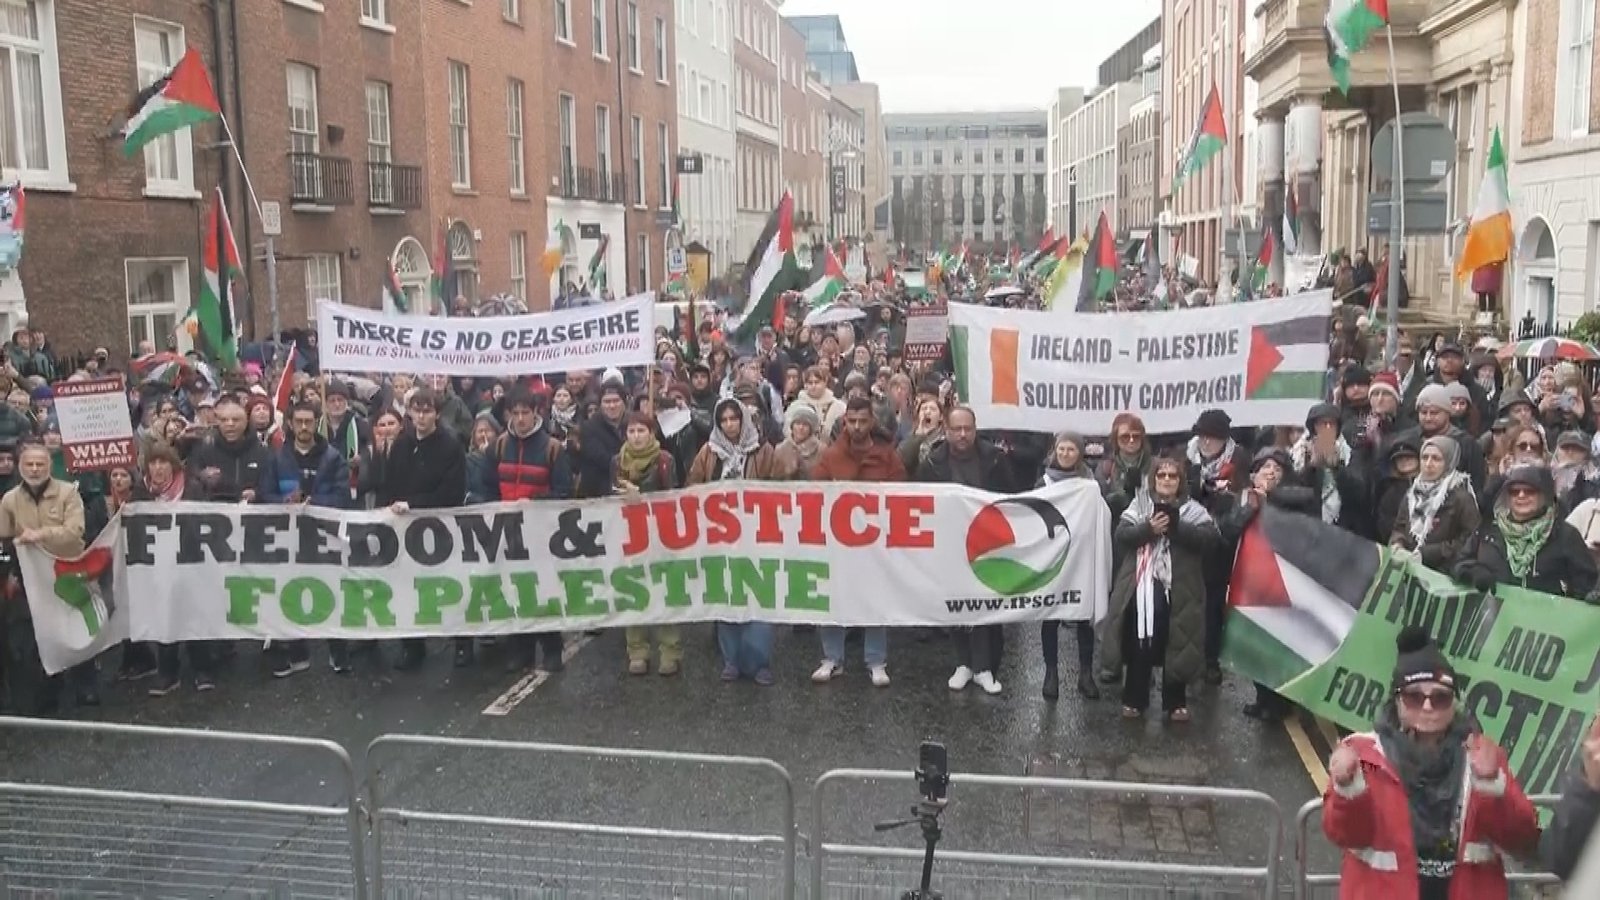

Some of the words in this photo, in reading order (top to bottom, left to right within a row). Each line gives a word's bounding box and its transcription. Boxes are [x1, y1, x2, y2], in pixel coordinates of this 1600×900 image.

[333, 315, 413, 347] THERE
[420, 329, 447, 350] IS
[455, 331, 492, 351] NO
[501, 309, 640, 350] CEASEFIRE
[908, 344, 944, 354] WHAT
[1031, 333, 1113, 363] IRELAND
[1137, 329, 1239, 363] PALESTINE
[334, 344, 372, 356] ISRAEL
[375, 346, 388, 357] IS
[390, 347, 420, 360] STILL
[478, 353, 501, 365] AND
[505, 347, 561, 364] SHOOTING
[564, 337, 640, 356] PALESTINIANS
[1022, 381, 1133, 411] SOLIDARITY
[1139, 373, 1243, 410] CAMPAIGN
[69, 441, 129, 459] WHAT
[121, 511, 530, 567] FREEDOM
[549, 508, 606, 559] &
[622, 491, 934, 557] JUSTICE
[224, 576, 396, 627] FOR
[413, 555, 830, 625] PALESTINE
[945, 589, 1081, 613] WWW.IPSC.IE
[1494, 626, 1566, 682] AND
[1324, 666, 1385, 722] FOR
